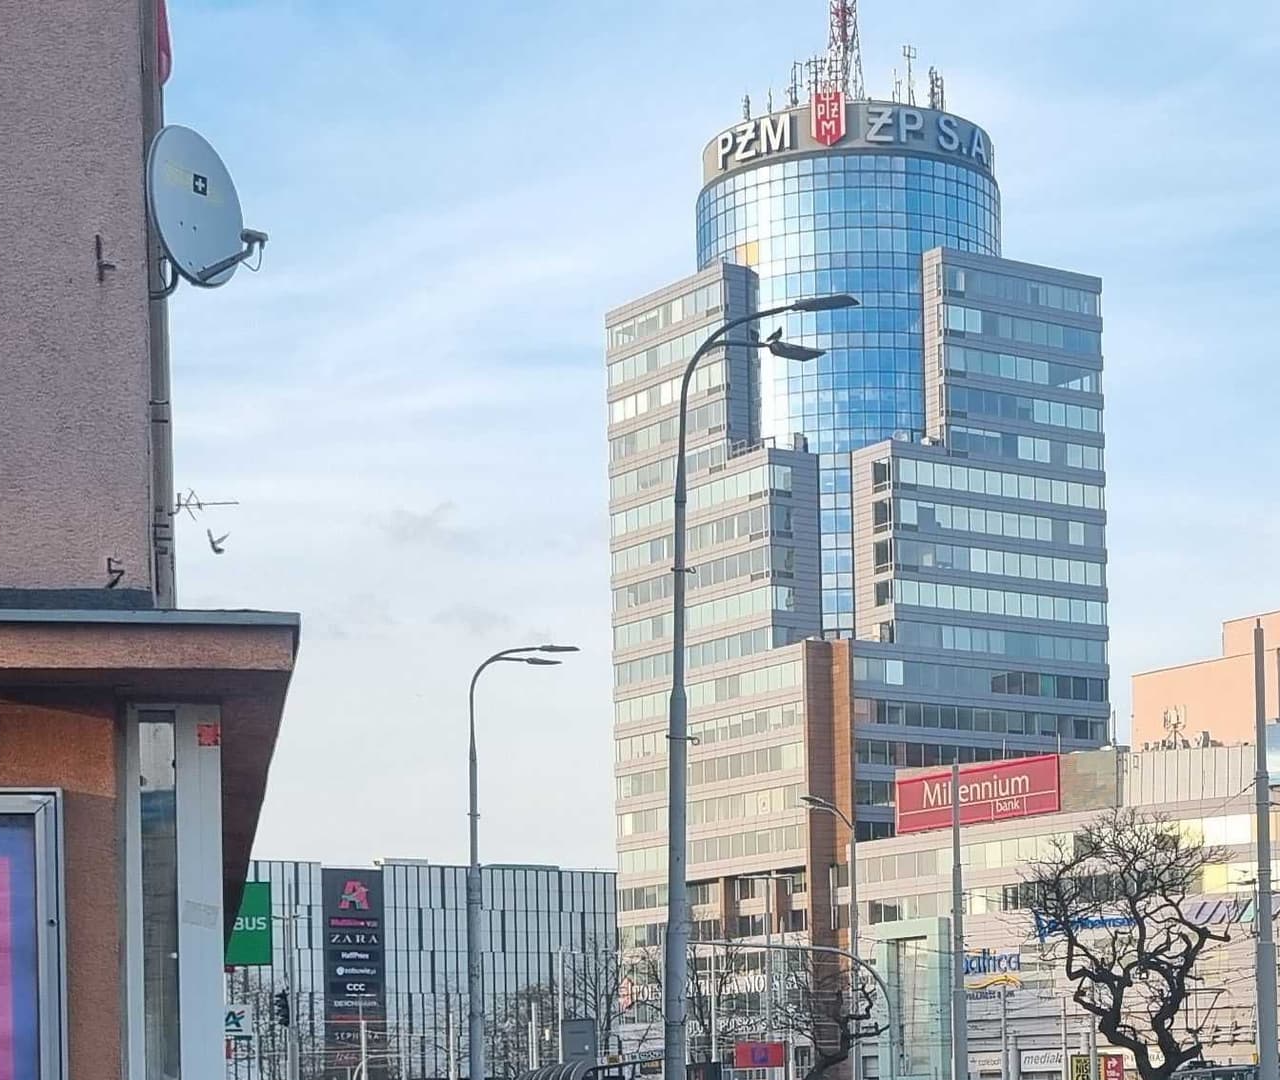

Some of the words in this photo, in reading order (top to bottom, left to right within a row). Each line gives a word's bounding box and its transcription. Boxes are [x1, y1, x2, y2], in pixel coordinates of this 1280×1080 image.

[923, 774, 1029, 809] Milennium
[996, 799, 1021, 813] bank
[331, 934, 379, 944] ZARA
[346, 983, 366, 991] CCC
